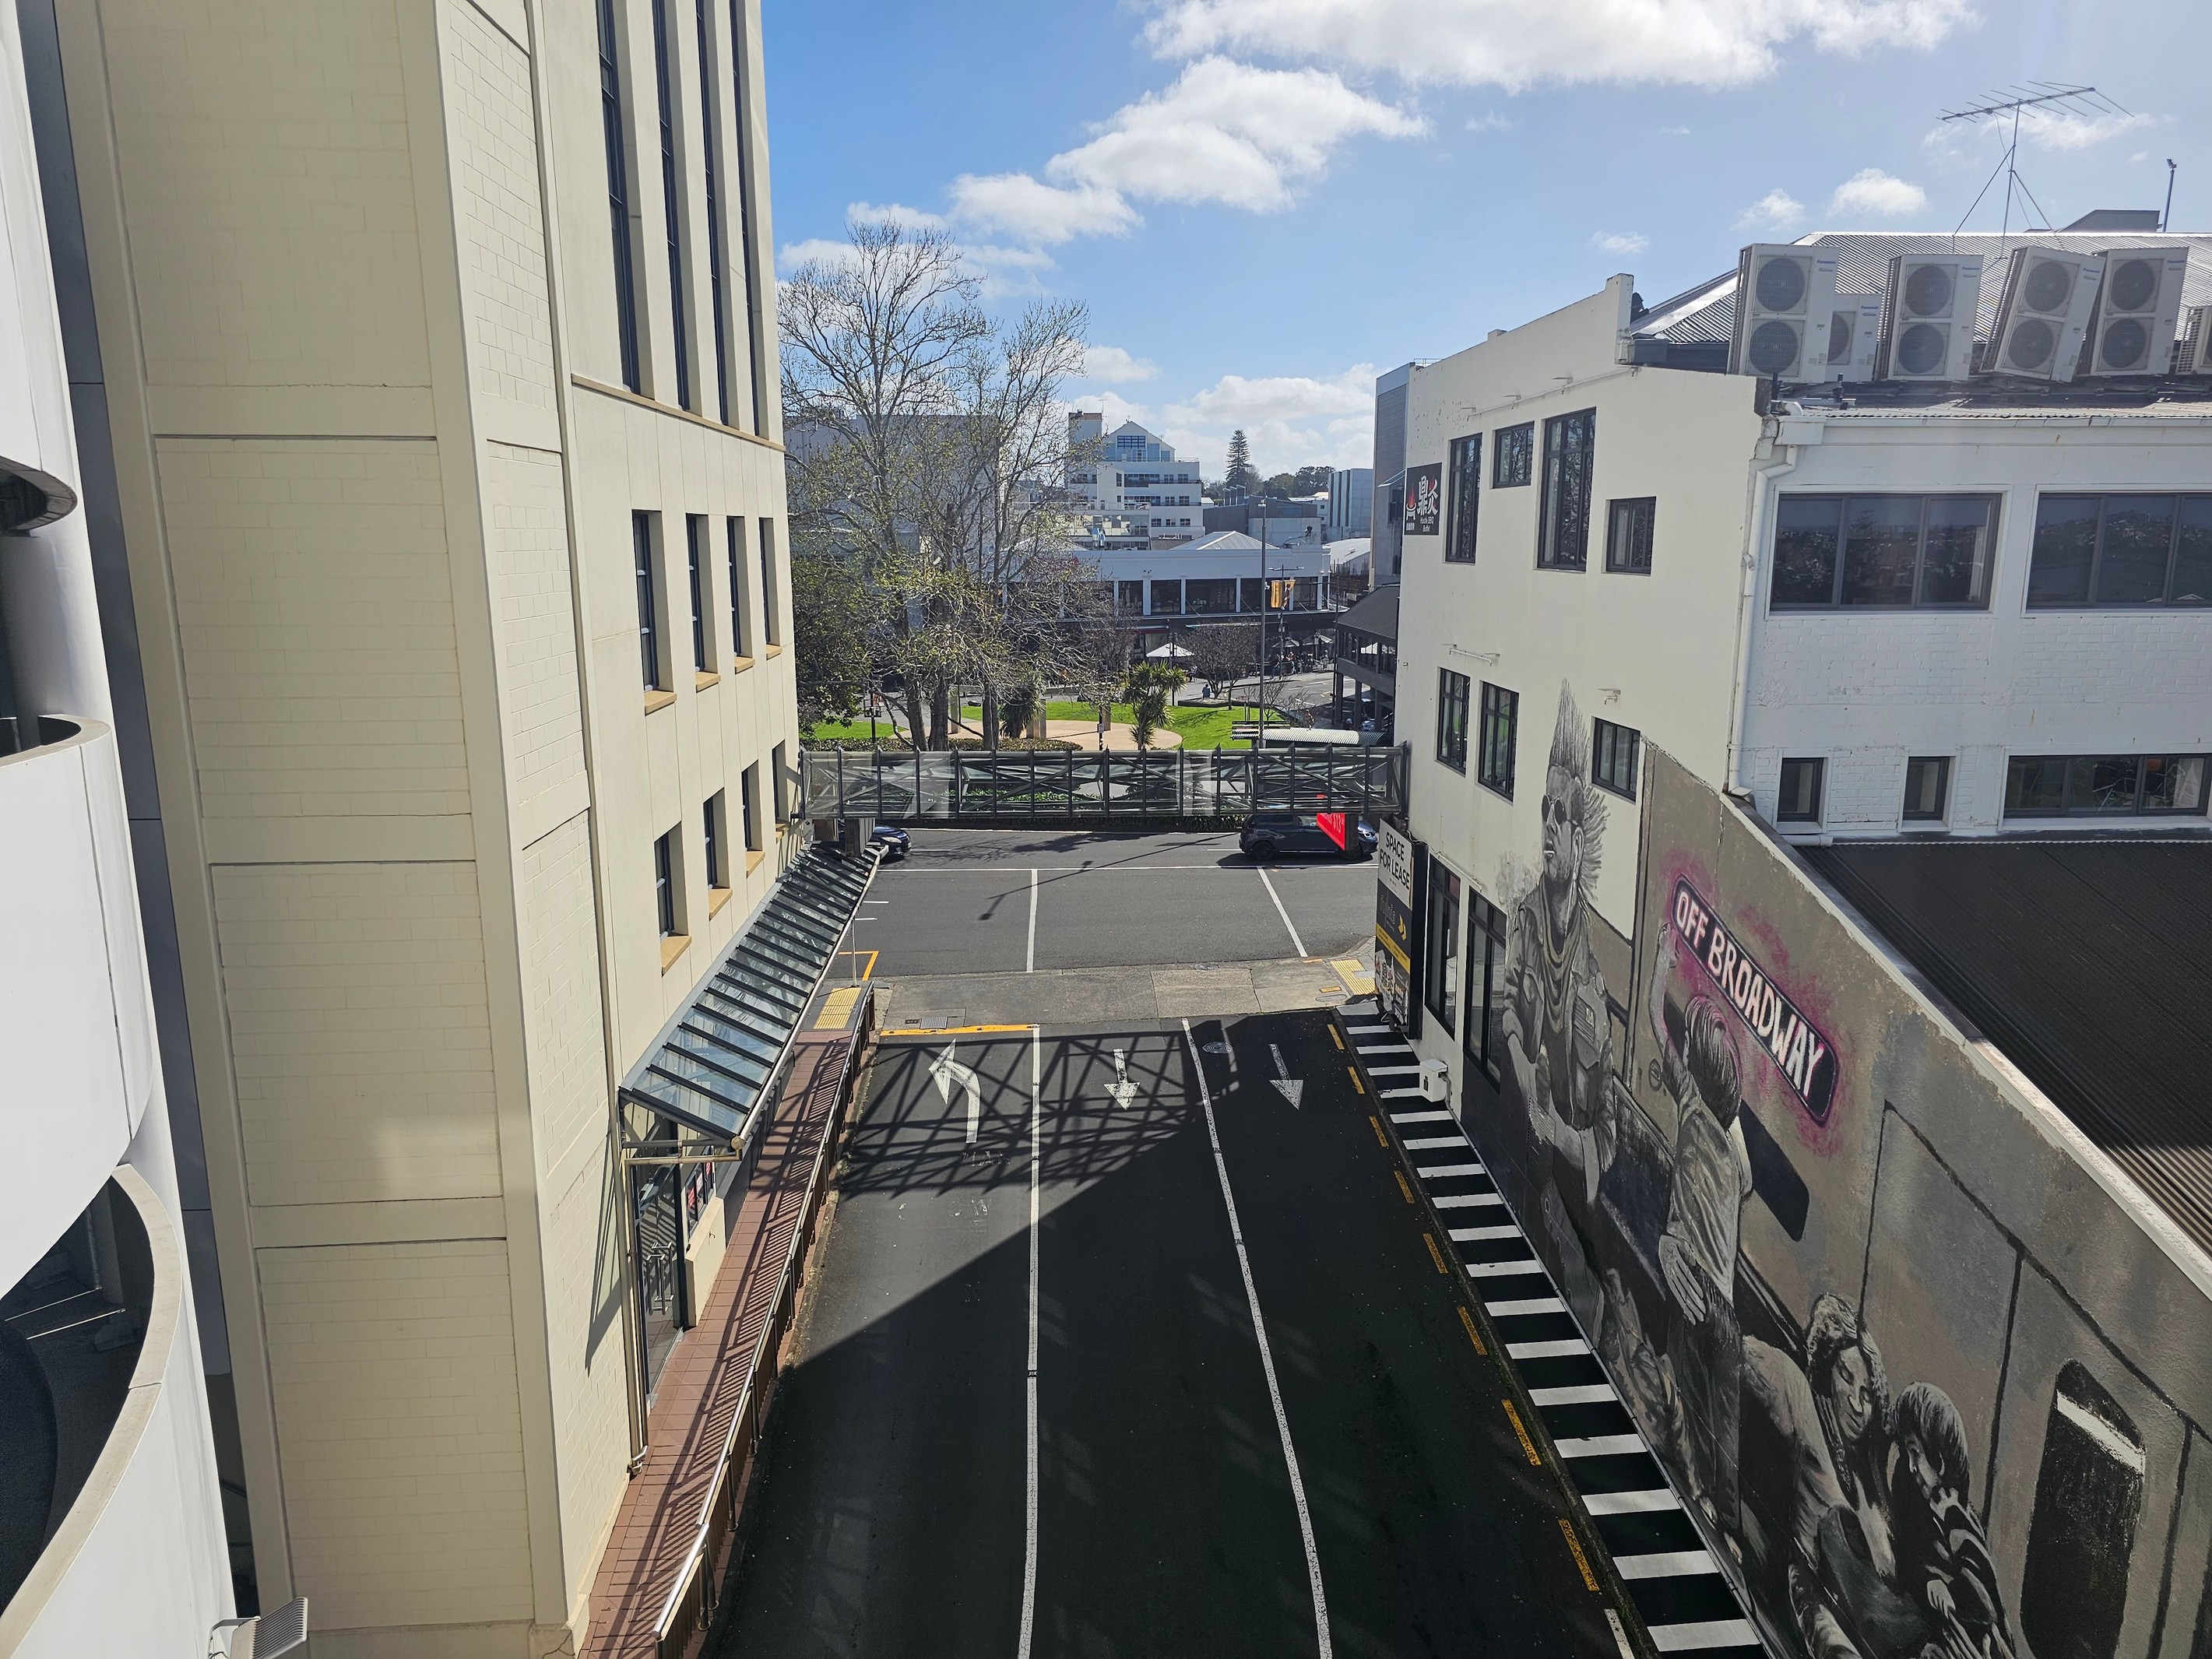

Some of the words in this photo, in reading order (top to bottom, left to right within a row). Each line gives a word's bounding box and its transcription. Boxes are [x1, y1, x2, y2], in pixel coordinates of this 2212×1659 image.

[1386, 831, 1405, 862] SPACE
[1380, 848, 1391, 872] FOR
[1391, 858, 1410, 891] LEASE
[1676, 891, 1708, 947] OFF
[1708, 926, 1824, 1098] BROADWAY
